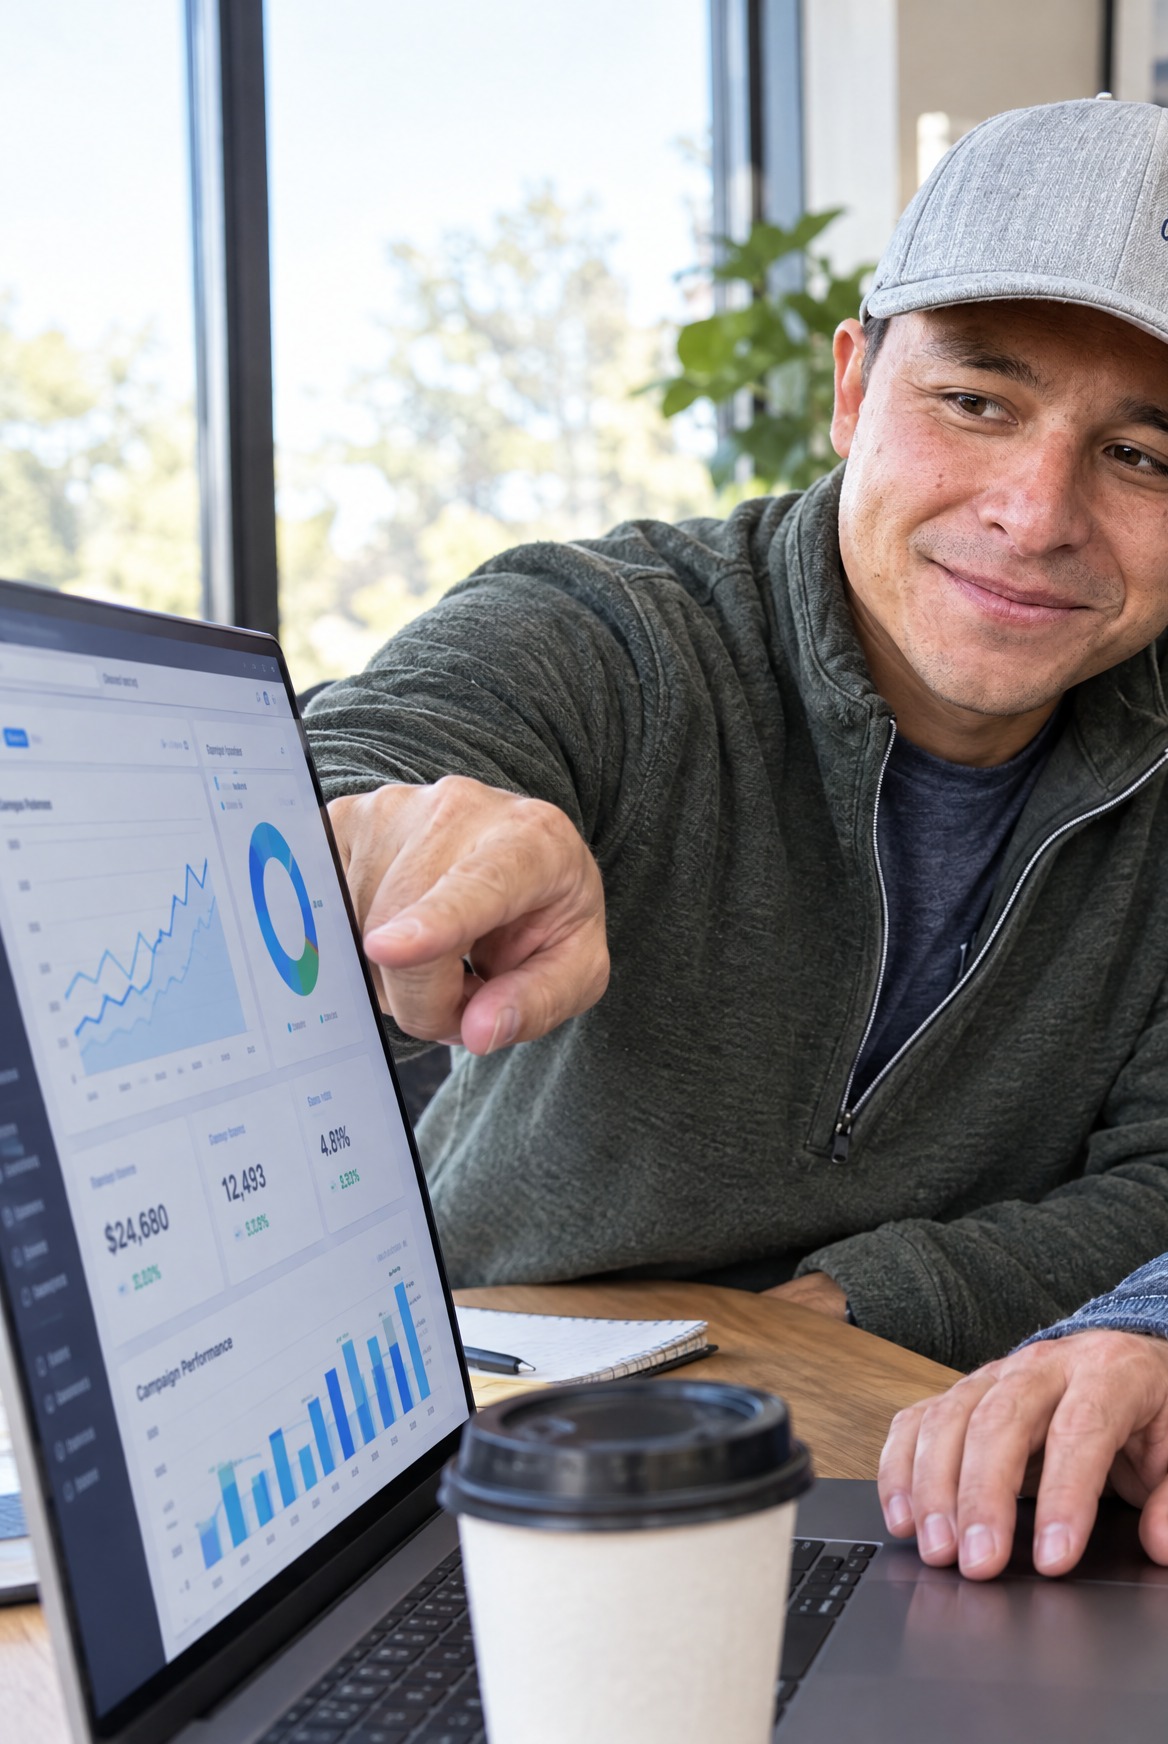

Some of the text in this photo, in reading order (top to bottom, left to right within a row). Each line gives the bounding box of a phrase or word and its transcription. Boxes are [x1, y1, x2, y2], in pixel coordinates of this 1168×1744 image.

[221, 1163, 267, 1202] 12,493
[104, 1203, 170, 1255] $24,680
[136, 1337, 233, 1402] Campaign Performance
